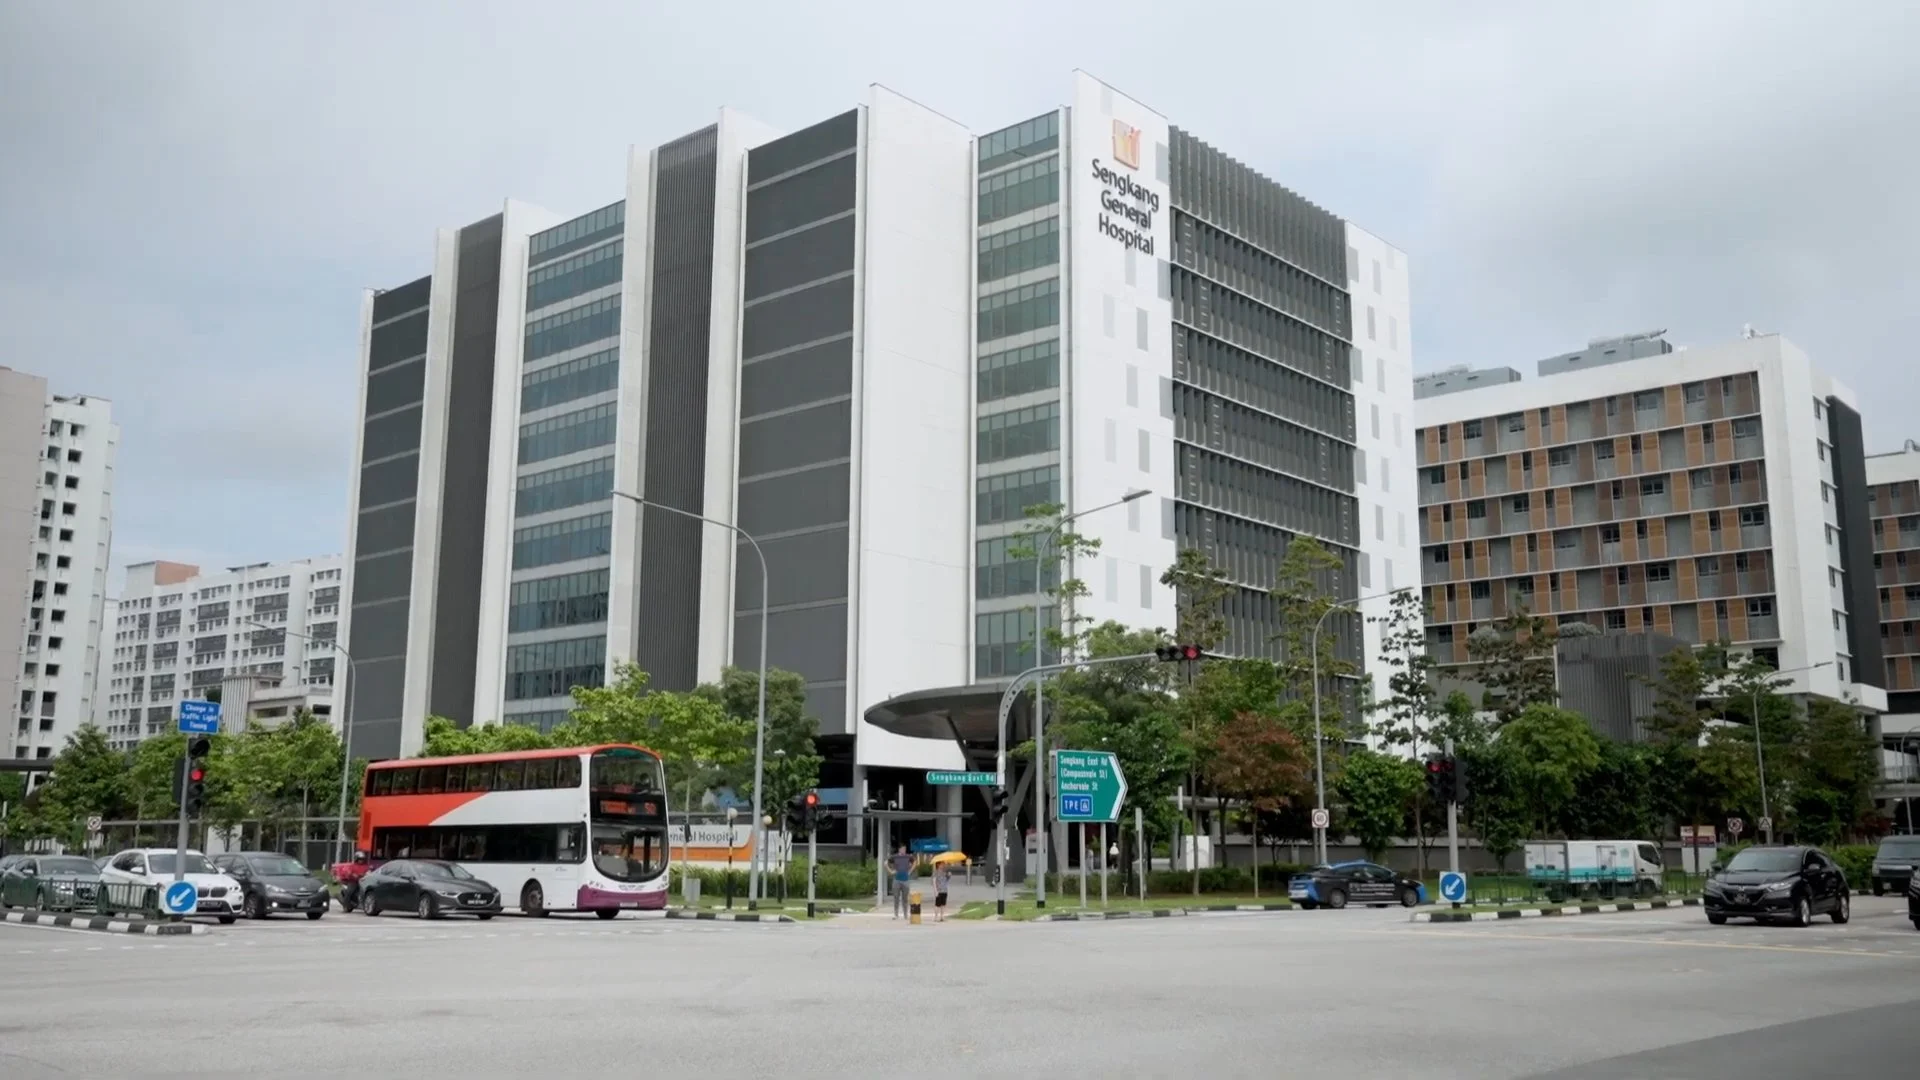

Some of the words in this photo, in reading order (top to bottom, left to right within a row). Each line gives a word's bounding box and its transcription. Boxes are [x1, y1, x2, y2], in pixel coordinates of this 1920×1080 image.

[1091, 158, 1159, 213] Sengkang
[1101, 189, 1151, 230] General
[1098, 212, 1154, 257] Hospital
[185, 704, 206, 713] Change
[202, 714, 217, 722] Light
[1060, 755, 1085, 767] Sengkang
[1087, 756, 1099, 766] East
[1100, 757, 1108, 766] Rd
[931, 773, 966, 783] Sengkang
[968, 773, 983, 783] East
[985, 773, 994, 782] Rd
[1091, 781, 1098, 791] St
[1064, 800, 1078, 810] TPE
